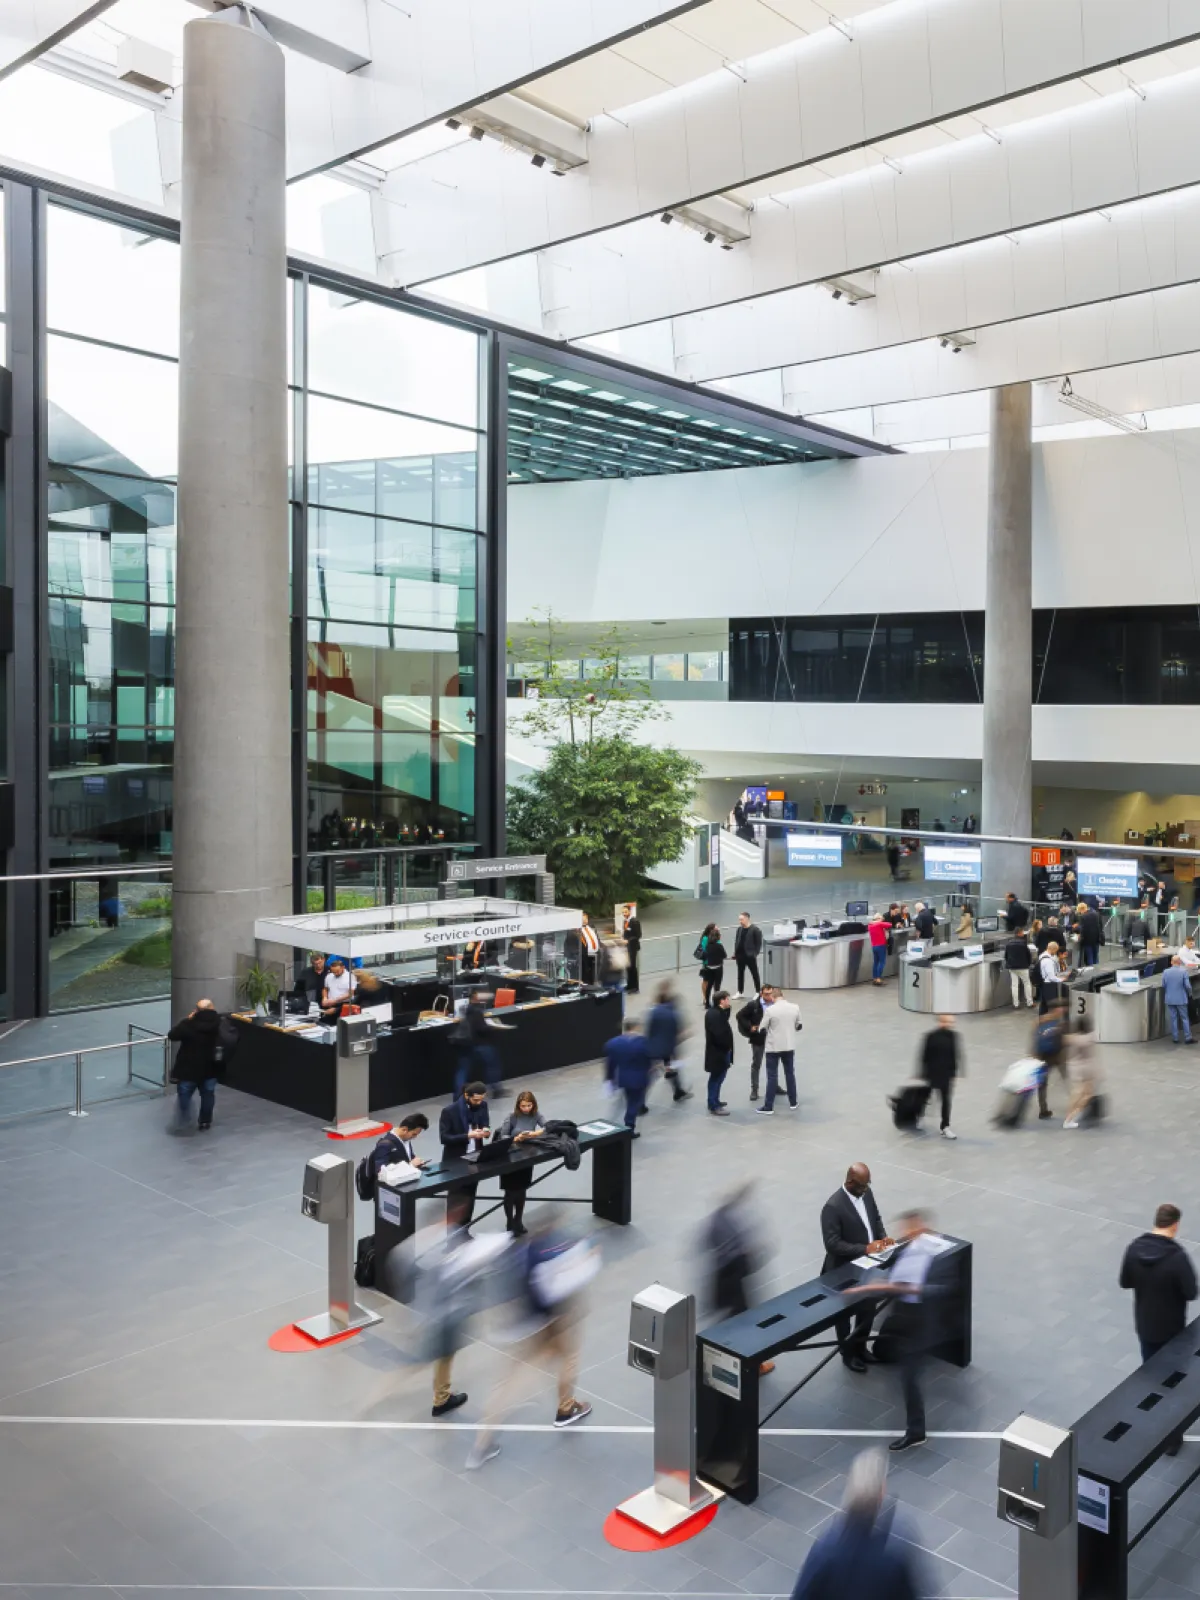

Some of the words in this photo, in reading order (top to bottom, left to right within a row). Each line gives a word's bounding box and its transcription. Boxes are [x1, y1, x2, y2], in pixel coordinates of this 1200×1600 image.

[475, 864, 503, 874] Service
[505, 862, 538, 872] Entrance
[424, 923, 522, 943] Service-Counter
[912, 972, 920, 988] 2
[1077, 996, 1086, 1015] 3
